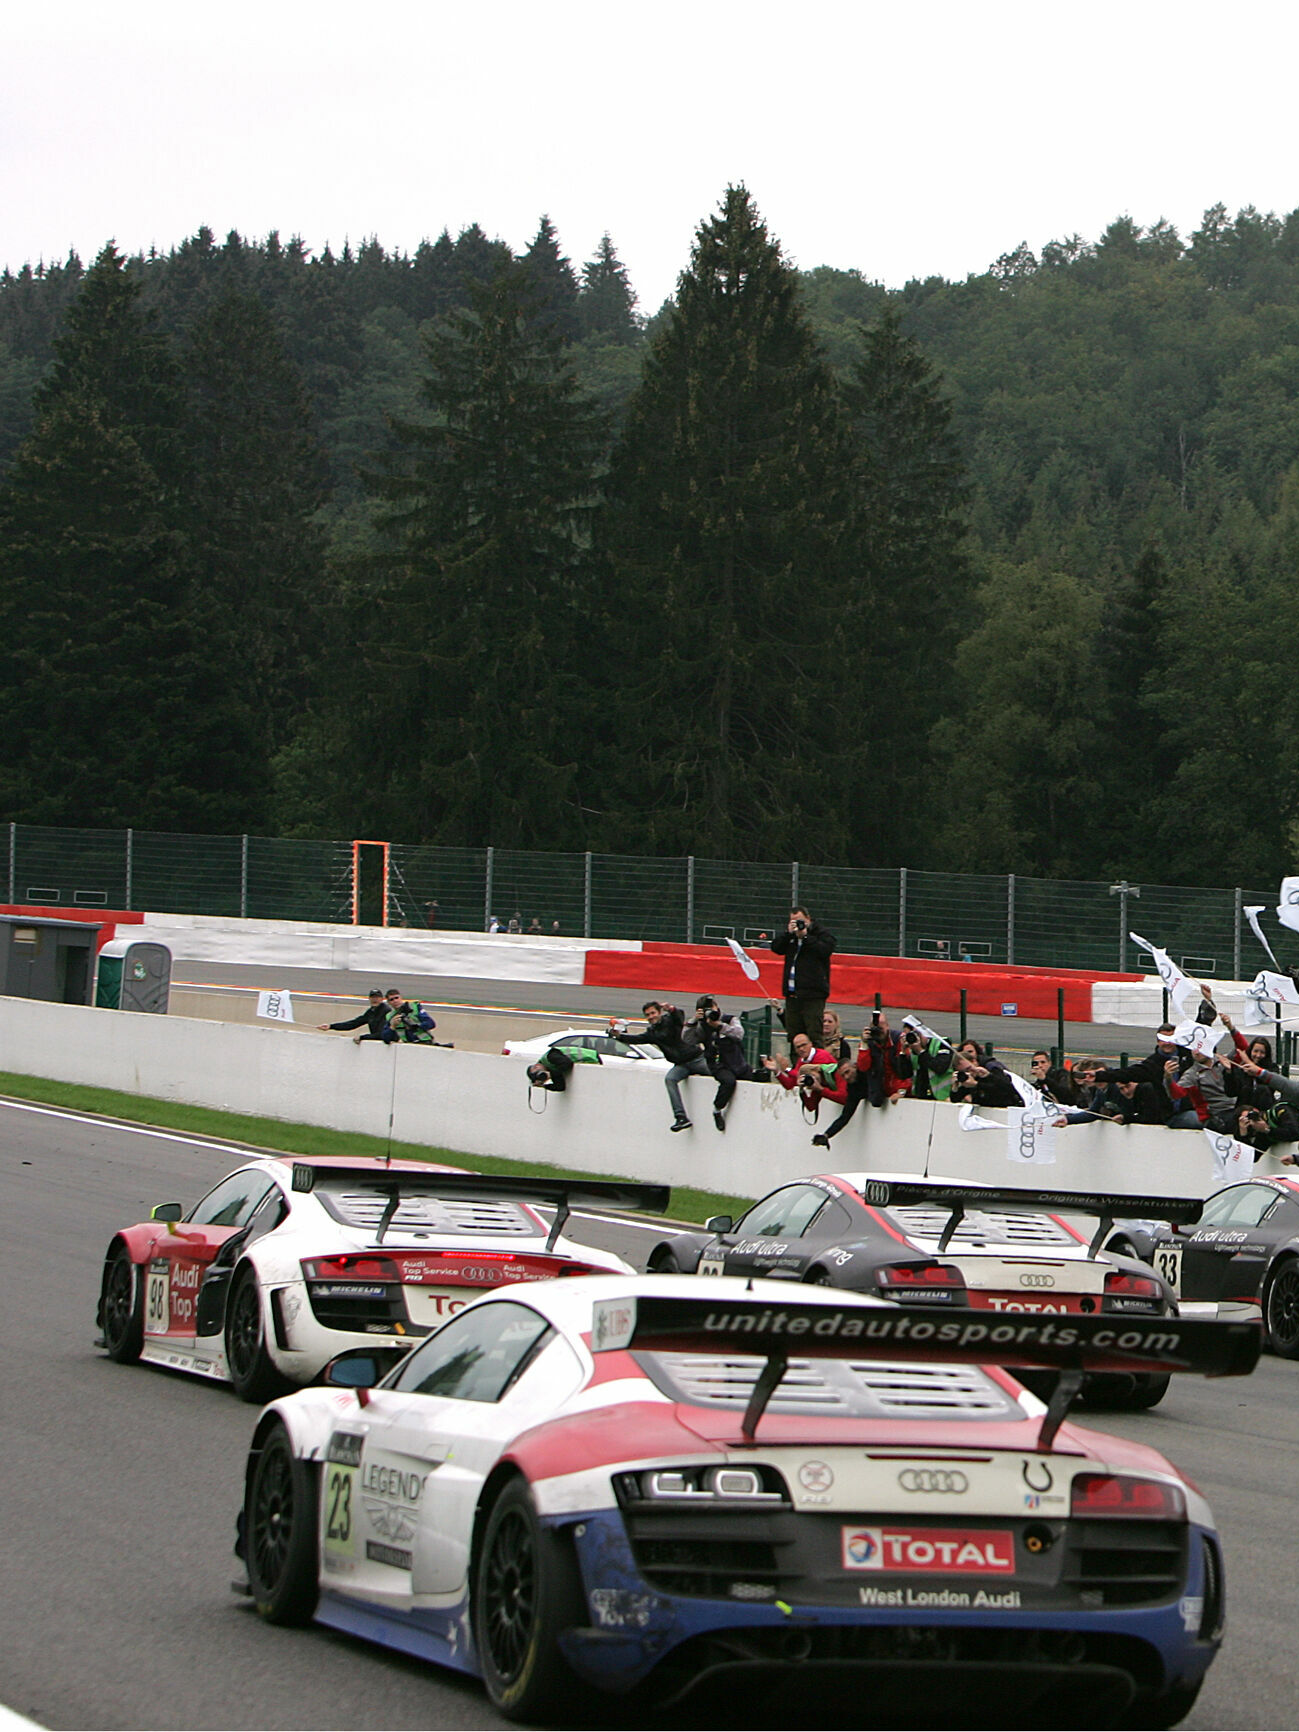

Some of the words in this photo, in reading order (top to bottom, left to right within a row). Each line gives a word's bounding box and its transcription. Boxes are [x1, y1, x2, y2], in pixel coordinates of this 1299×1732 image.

[730, 1240, 762, 1254] Audi
[1189, 1231, 1220, 1243] Audi
[1218, 1230, 1248, 1243] ultra
[171, 1263, 200, 1288] Audi
[423, 1267, 459, 1276] Service
[503, 1264, 526, 1272] Audi
[504, 1272, 522, 1280] Top
[1158, 1253, 1178, 1287] 33
[150, 1277, 164, 1321] 98
[330, 1285, 382, 1294] MICHELIN
[901, 1290, 949, 1299] MICHELIN
[171, 1291, 192, 1323] Top
[704, 1311, 1181, 1350] unitedautosports.com
[327, 1472, 352, 1542] 23
[883, 1534, 1010, 1566] TOTAL
[859, 1587, 903, 1606] West
[906, 1588, 970, 1607] London
[973, 1590, 1021, 1608] Audi
